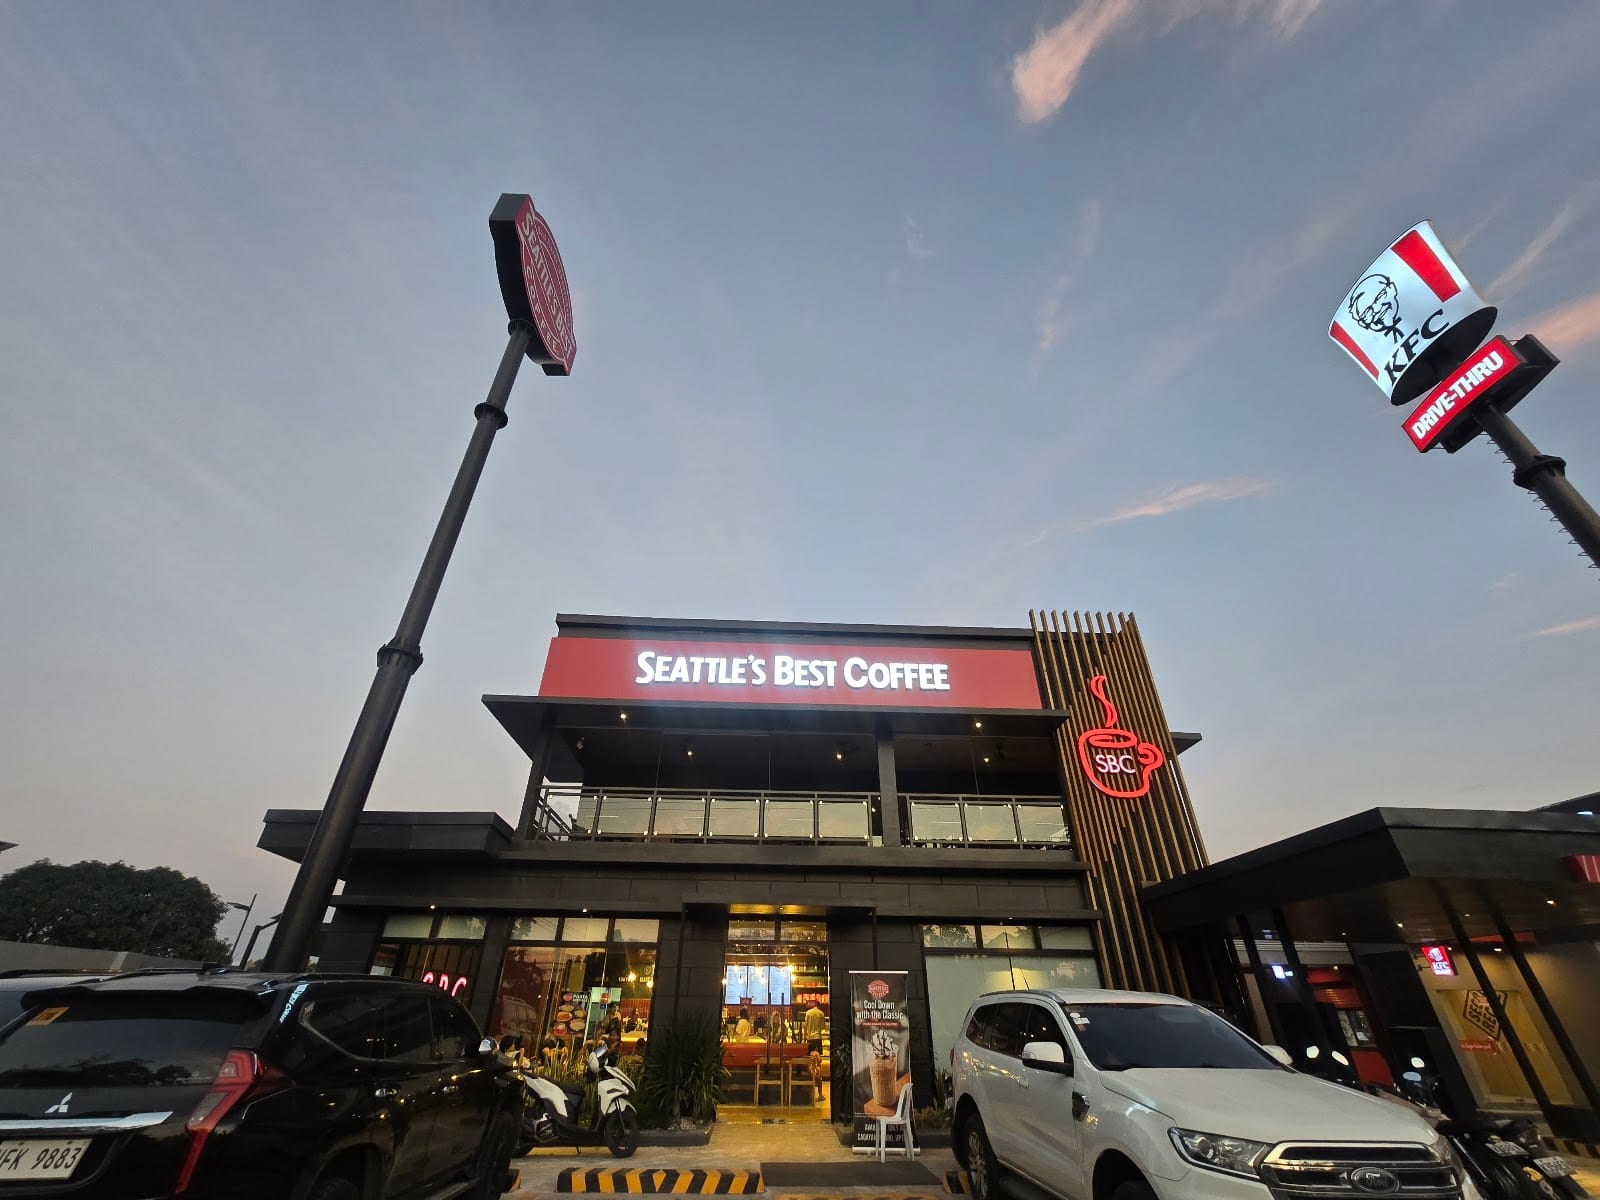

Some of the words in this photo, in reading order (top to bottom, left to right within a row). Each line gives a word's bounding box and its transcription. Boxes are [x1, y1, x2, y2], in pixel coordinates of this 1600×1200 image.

[526, 264, 558, 351] COFFEE
[555, 314, 573, 359] BEST
[1384, 308, 1450, 385] KFC
[1411, 350, 1504, 440] DRIVE-THRU
[634, 651, 766, 685] SEATTLE'S
[773, 655, 836, 687] BEST
[843, 656, 951, 691] COFFEE
[1095, 754, 1137, 774] SBC
[1431, 961, 1450, 970] KFC
[855, 1009, 870, 1019] with
[871, 1010, 882, 1019] the
[882, 1009, 904, 1020] Classic
[863, 999, 877, 1009] Cool
[877, 999, 895, 1009] Down
[30, 1147, 83, 1170] 9883
